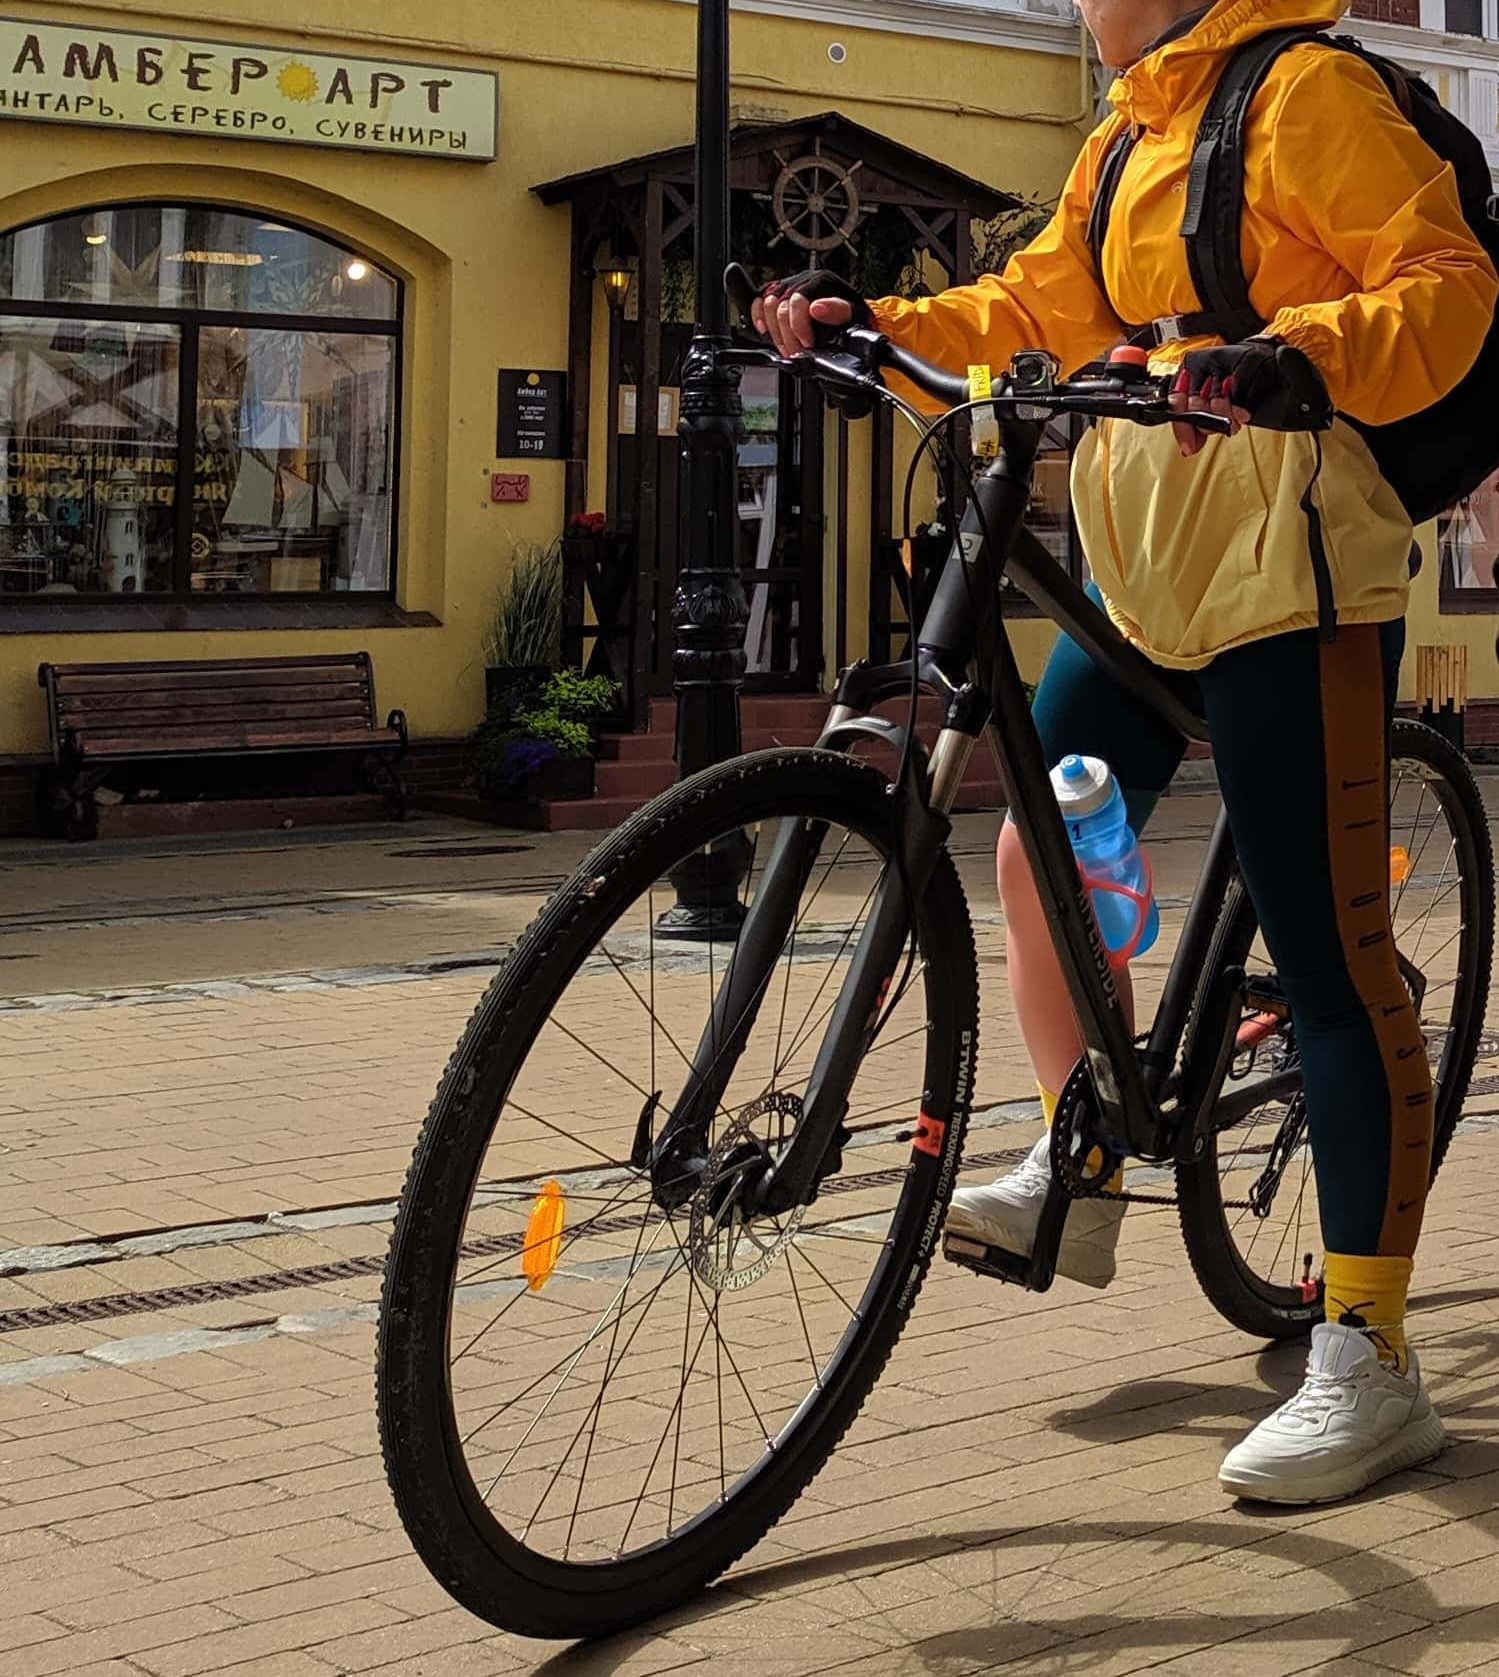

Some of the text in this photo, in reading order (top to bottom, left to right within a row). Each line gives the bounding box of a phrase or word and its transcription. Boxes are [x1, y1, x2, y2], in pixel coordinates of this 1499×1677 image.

[12, 33, 453, 114] АМБЕР АРТ
[147, 102, 294, 135] СЕРЕБРО,
[316, 119, 467, 150] СУВЕНИРЫ
